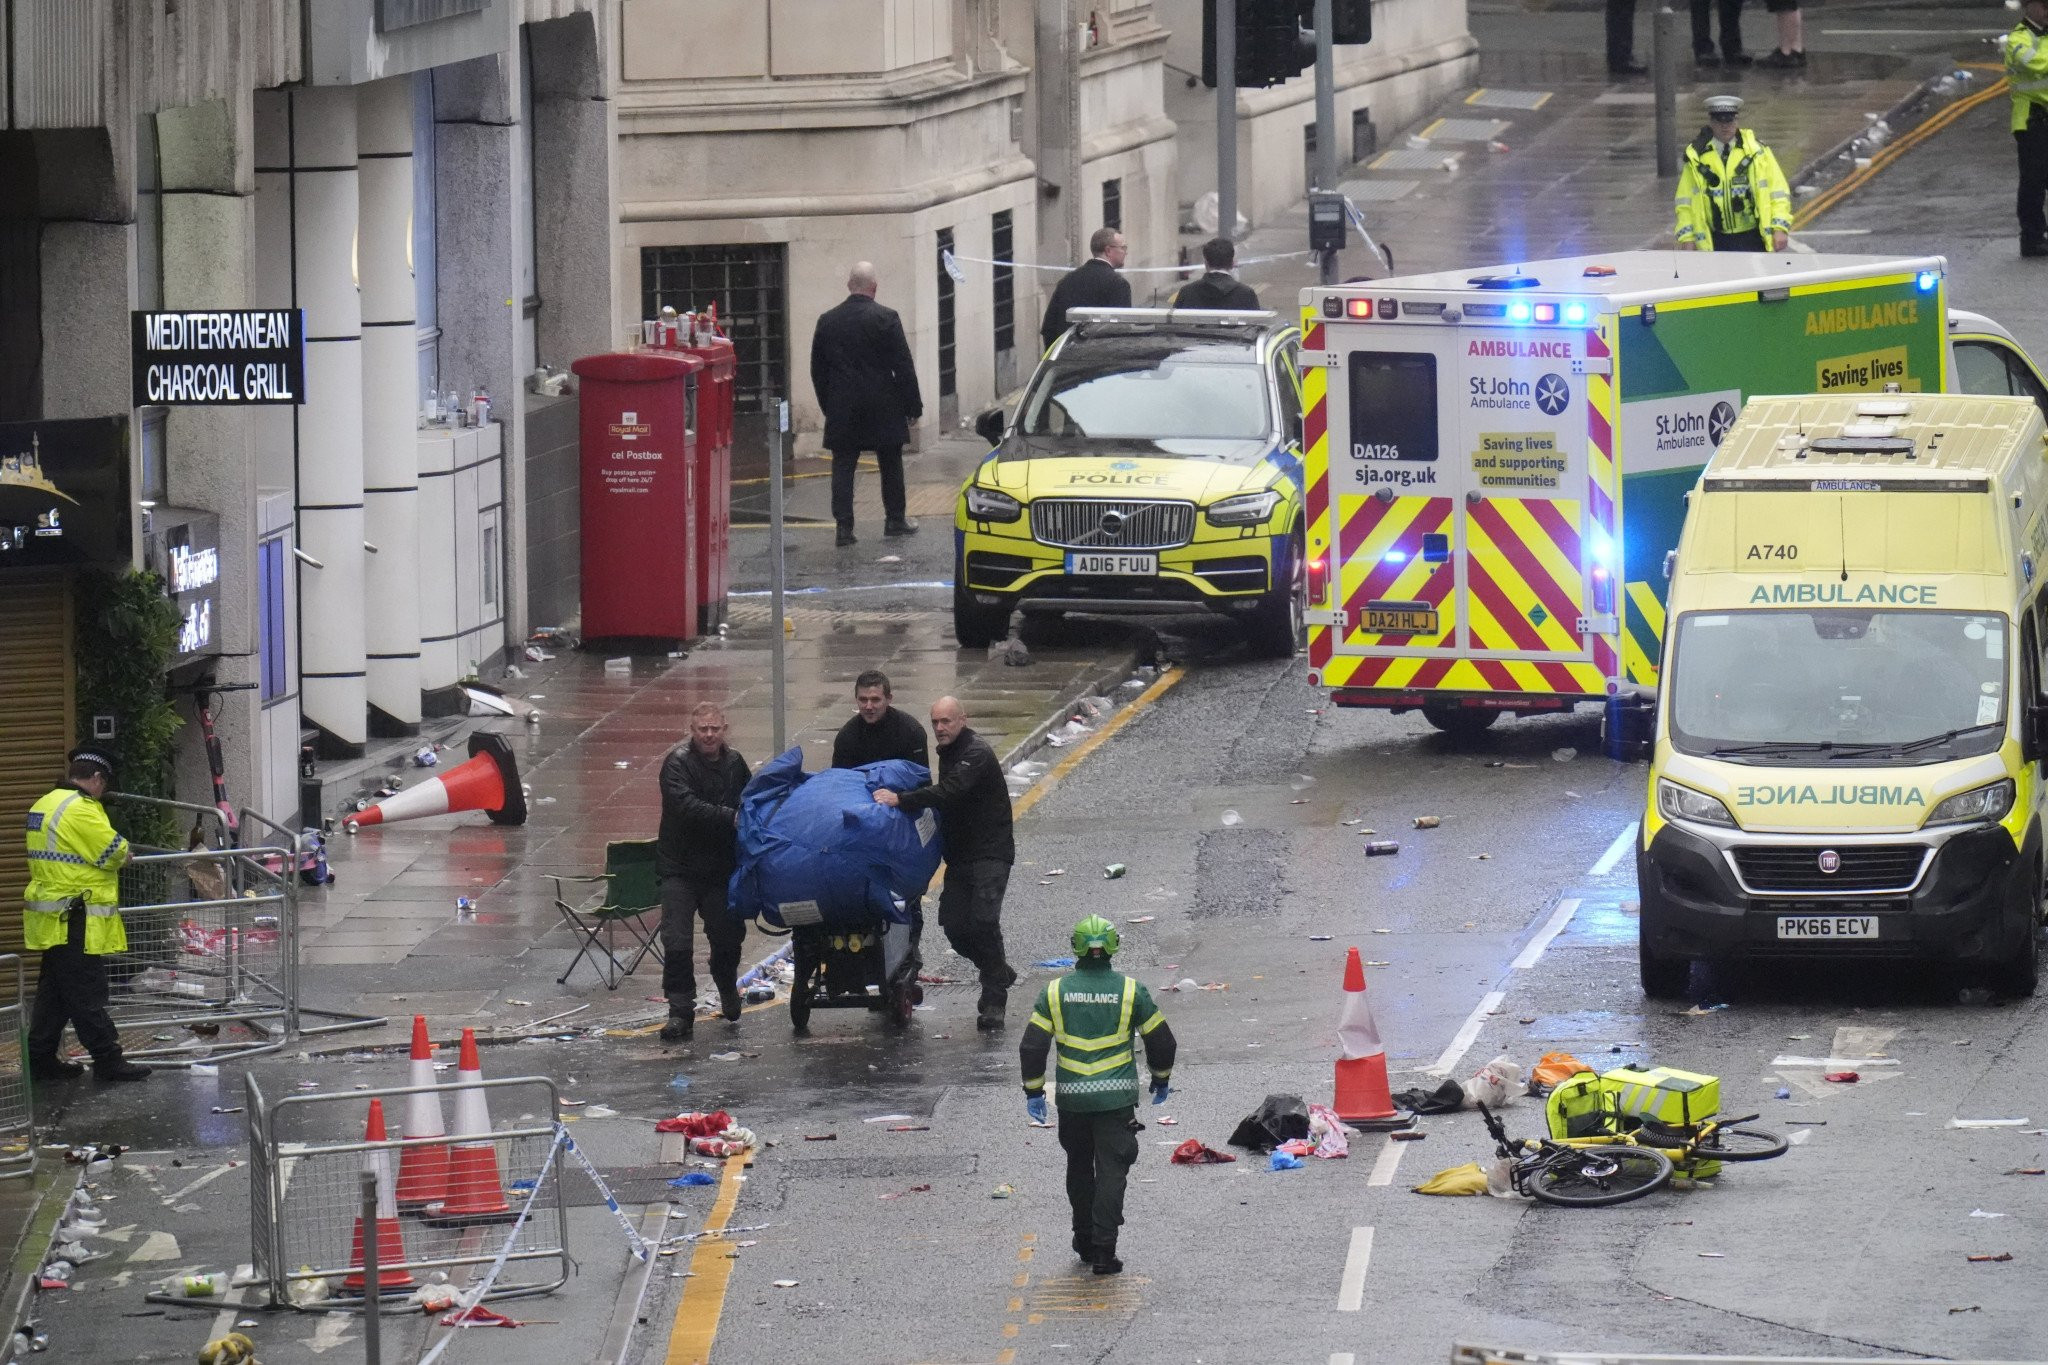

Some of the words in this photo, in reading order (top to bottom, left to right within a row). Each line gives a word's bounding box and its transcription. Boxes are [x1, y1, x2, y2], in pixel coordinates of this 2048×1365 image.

[1805, 300, 1918, 336] AMBULANCE
[145, 312, 290, 351] MEDITERRANEAN
[1467, 340, 1572, 358] AMBULANCE
[147, 363, 241, 401] CHARCOAL
[243, 362, 293, 400] GRILL
[1821, 366, 1868, 389] Saving
[1871, 359, 1904, 380] lives
[1469, 376, 1487, 395] St
[1491, 377, 1530, 396] John
[1470, 397, 1531, 410] Ambulance
[611, 426, 631, 434] Royal
[632, 426, 648, 434] Mail
[1656, 414, 1670, 436] St
[1671, 411, 1705, 434] John
[1483, 437, 1523, 452] Saving
[1525, 437, 1553, 450] lives
[1656, 435, 1705, 451] Ambulance
[626, 450, 662, 460] Postbox
[1353, 443, 1399, 460] DA126
[1474, 456, 1497, 469] and
[1499, 457, 1565, 472] supporting
[1069, 474, 1169, 486] POLICE
[1355, 465, 1436, 487] sja.org.uk
[1481, 474, 1556, 487] communities
[1816, 481, 1877, 490] AMBULANCE
[1746, 545, 1798, 560] A740
[1079, 557, 1114, 572] AD16
[1119, 557, 1150, 572] FUU
[1750, 583, 1938, 605] AMBULANCE
[1369, 612, 1399, 628] DA21
[1402, 612, 1429, 629] HLJ
[1823, 857, 1836, 867] FIAT
[1785, 919, 1831, 936] PK66
[1836, 918, 1871, 935] ECV
[1063, 992, 1119, 1004] AMBULANCE
